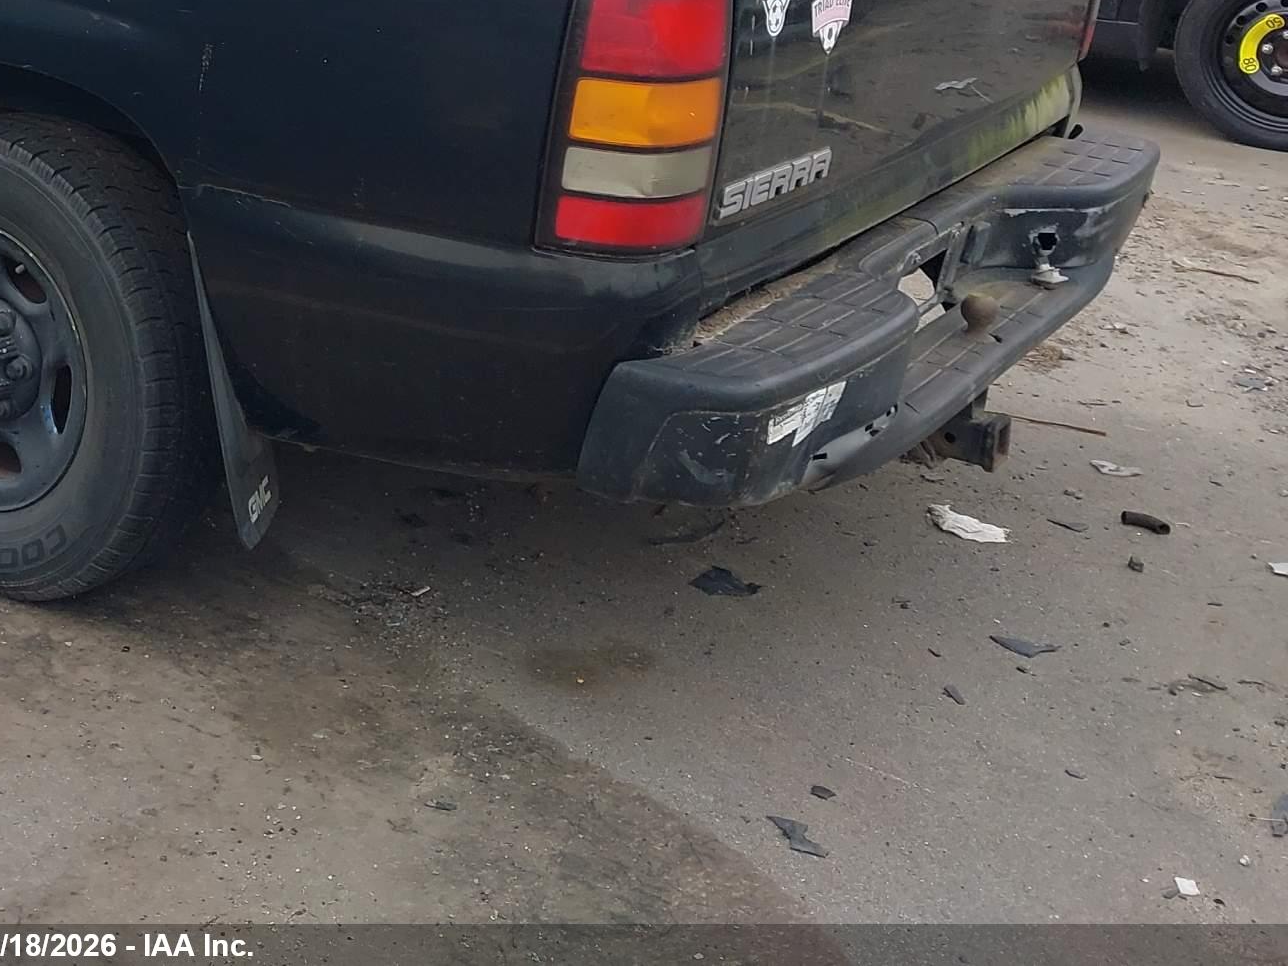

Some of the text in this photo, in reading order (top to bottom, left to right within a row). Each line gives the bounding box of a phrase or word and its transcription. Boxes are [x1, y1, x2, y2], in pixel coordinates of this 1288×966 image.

[1242, 57, 1257, 72] 80
[718, 146, 833, 220] SIERRA
[248, 474, 272, 523] GMC
